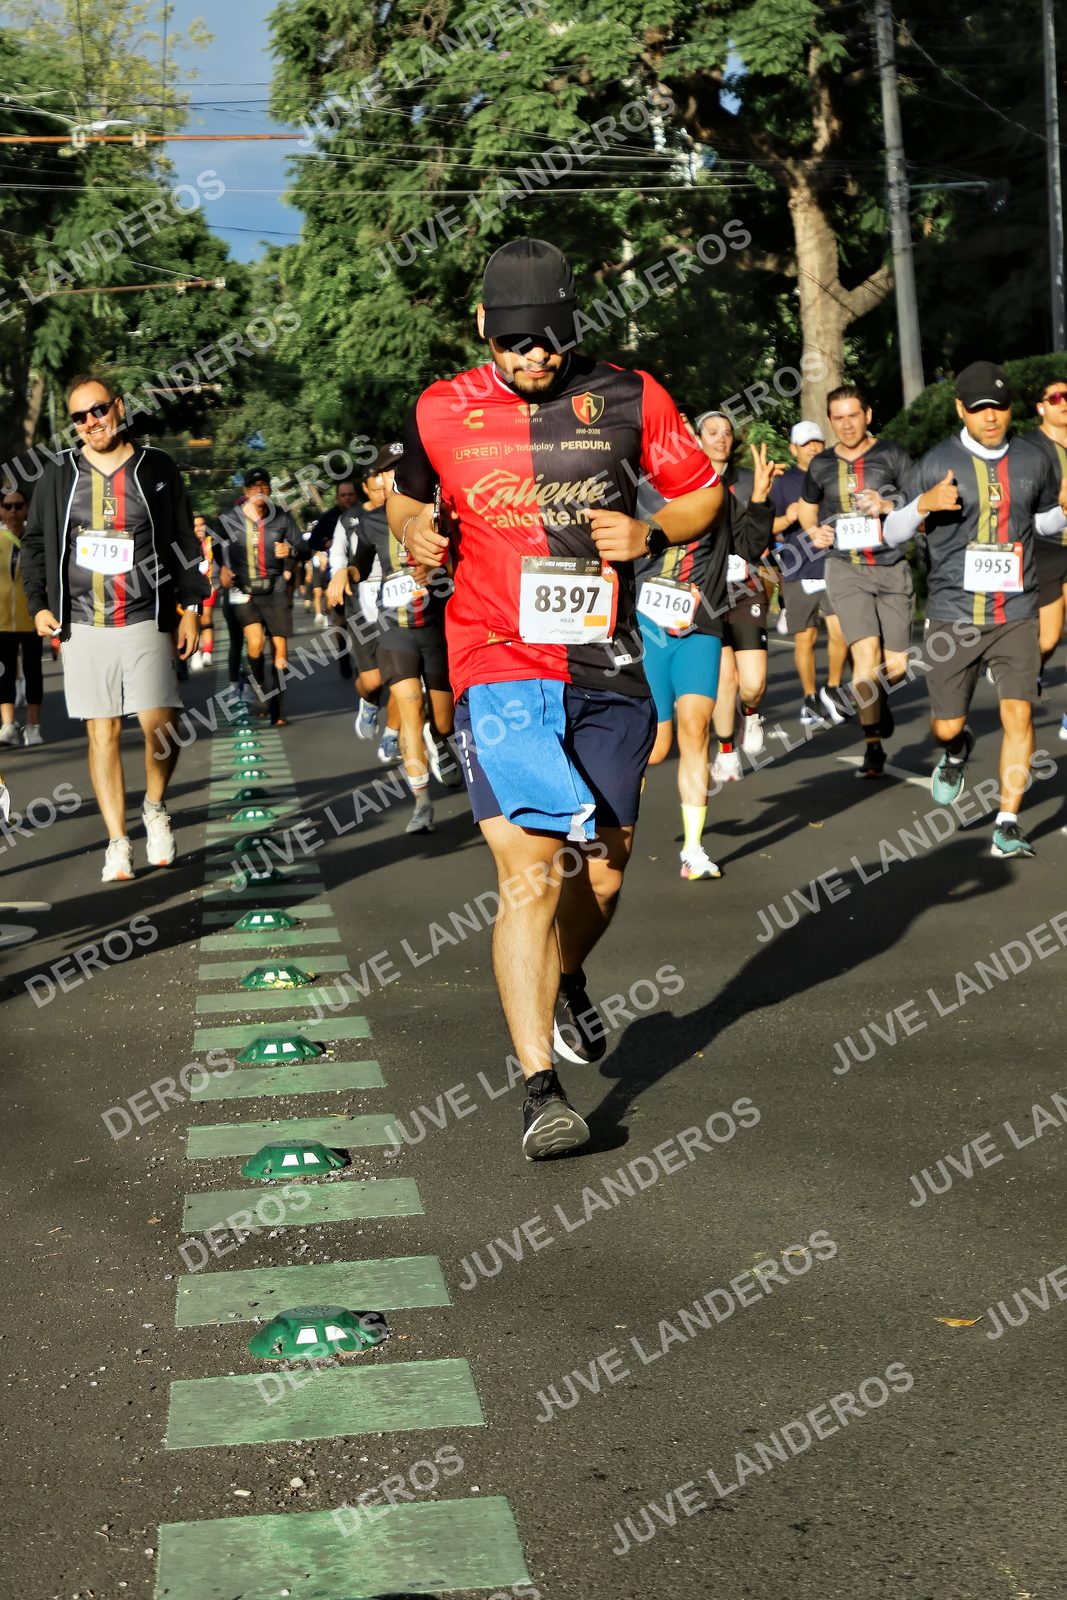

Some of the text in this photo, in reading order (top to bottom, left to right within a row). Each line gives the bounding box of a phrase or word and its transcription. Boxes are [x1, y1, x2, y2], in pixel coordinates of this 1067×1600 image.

[515, 442, 554, 452] Totalplay
[560, 440, 612, 450] PERDURA
[462, 469, 608, 514] Caliente
[842, 522, 870, 536] 9328
[92, 543, 118, 558] 719
[974, 558, 1012, 574] 9955
[534, 585, 600, 614] 8397
[646, 590, 691, 614] 12160
